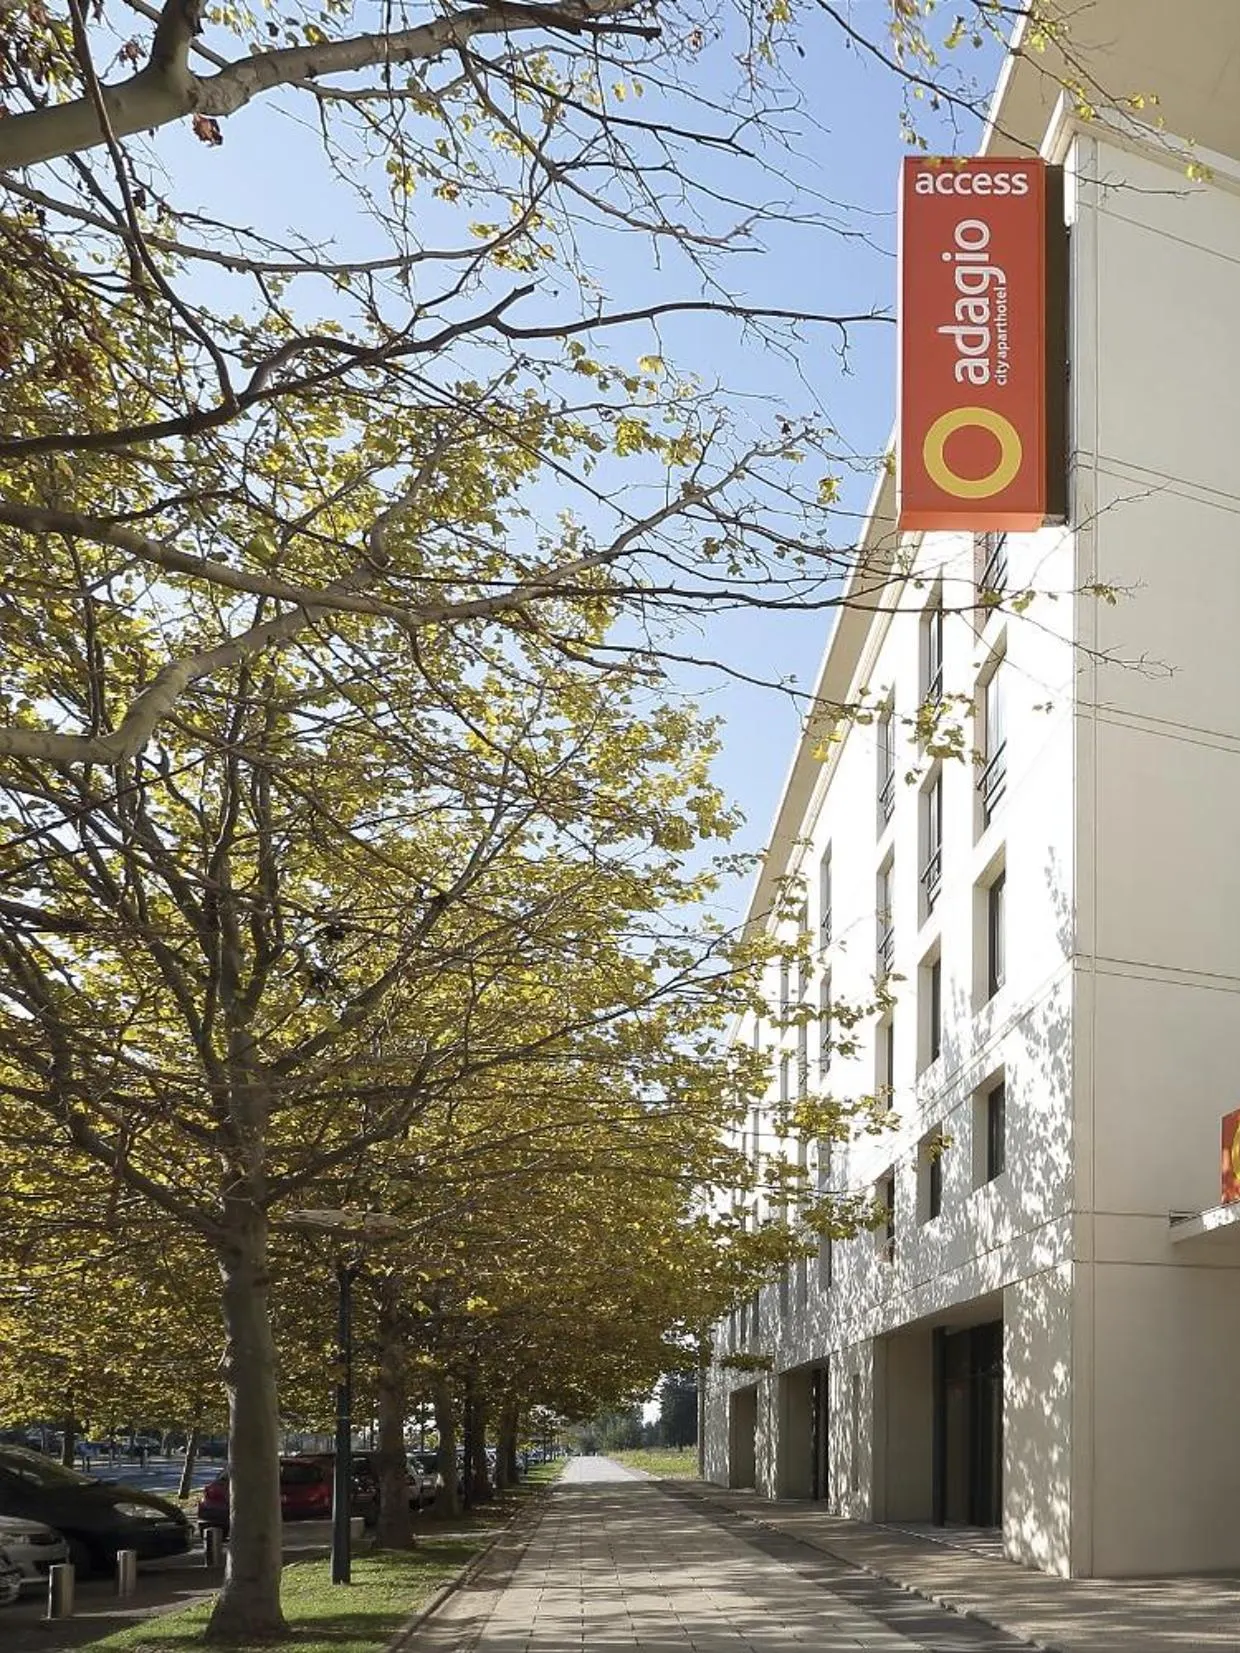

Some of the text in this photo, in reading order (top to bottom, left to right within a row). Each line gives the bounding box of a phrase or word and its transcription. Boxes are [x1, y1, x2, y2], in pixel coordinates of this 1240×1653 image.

[915, 172, 1029, 195] access
[937, 218, 1006, 386] adagio
[993, 287, 1011, 386] city aparthotel
